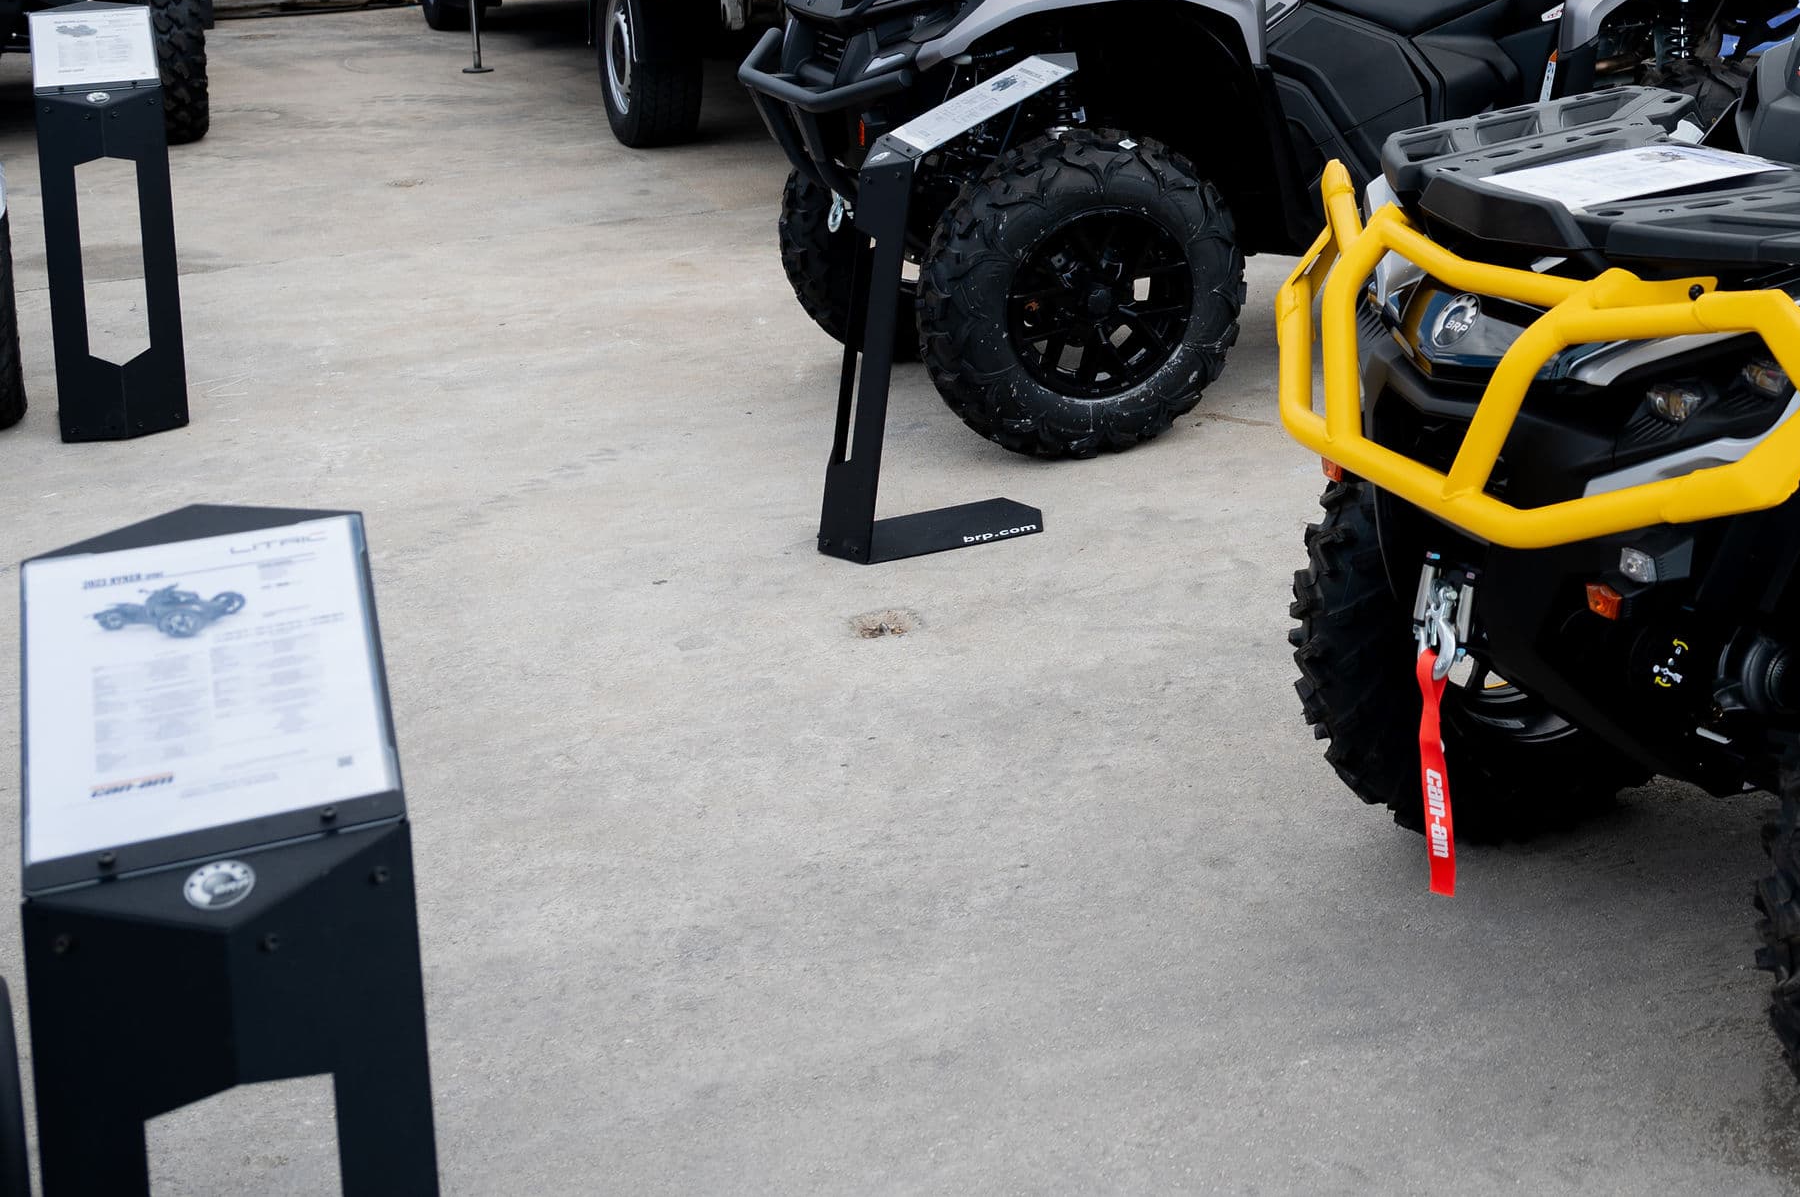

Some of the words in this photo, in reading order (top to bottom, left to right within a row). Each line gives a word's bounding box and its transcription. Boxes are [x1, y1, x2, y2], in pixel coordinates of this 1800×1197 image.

[1444, 319, 1469, 333] BRP
[962, 523, 1037, 543] brp.com
[1425, 768, 1449, 859] can-am
